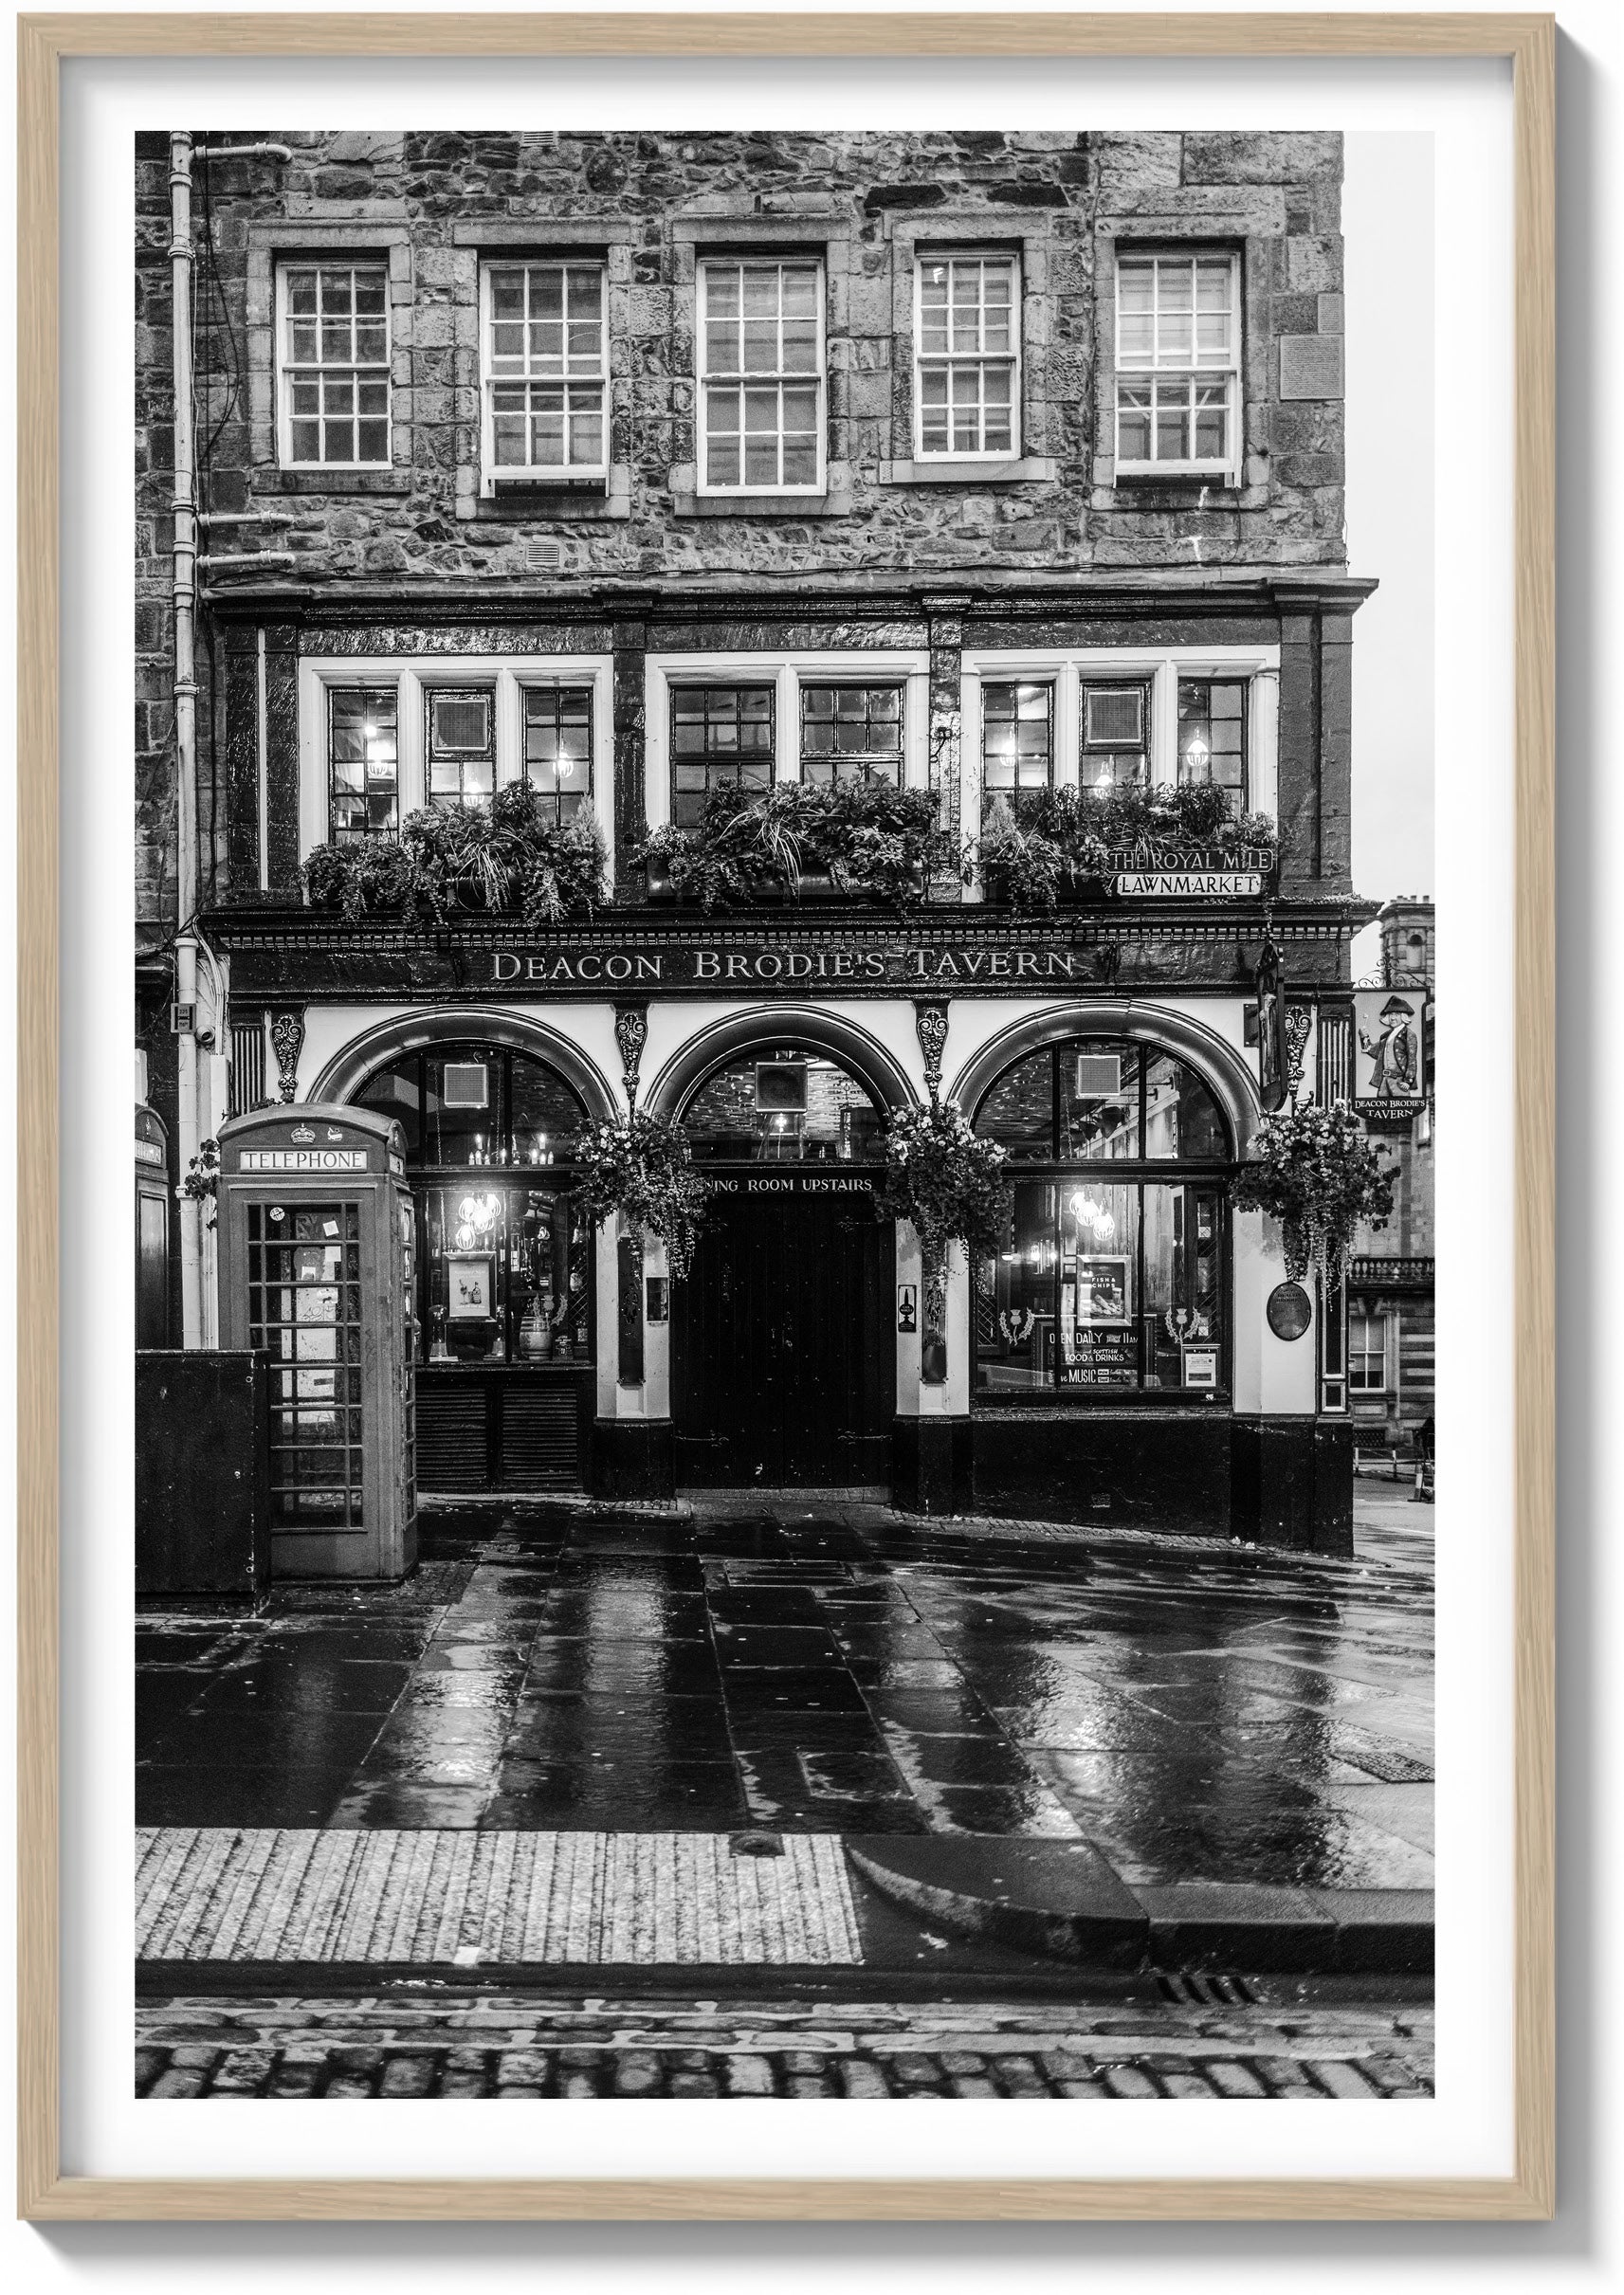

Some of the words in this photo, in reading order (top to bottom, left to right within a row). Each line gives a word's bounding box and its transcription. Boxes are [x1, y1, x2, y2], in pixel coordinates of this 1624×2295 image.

[1109, 852, 1146, 869] THE
[1153, 852, 1215, 869] ROYAL
[1223, 852, 1269, 869] MILE
[1122, 876, 1258, 894] LAWNMARKET
[490, 953, 664, 980] DEACON
[693, 951, 885, 979] BRODIE'S
[907, 949, 1074, 976] TAVERN
[1355, 1100, 1388, 1109] DEACON
[1390, 1100, 1426, 1108] BRODIE'S
[1365, 1109, 1414, 1120] TAVERN
[246, 1152, 362, 1169] TELEPHONE
[747, 1179, 794, 1192] ROOM
[802, 1178, 872, 1191] UPSTAIRS
[1049, 1332, 1072, 1344] OEN
[1075, 1331, 1104, 1344] DAILY
[1065, 1354, 1088, 1362] FOOD
[1095, 1354, 1124, 1362] DRINKS
[1068, 1369, 1097, 1383] MUSIC
